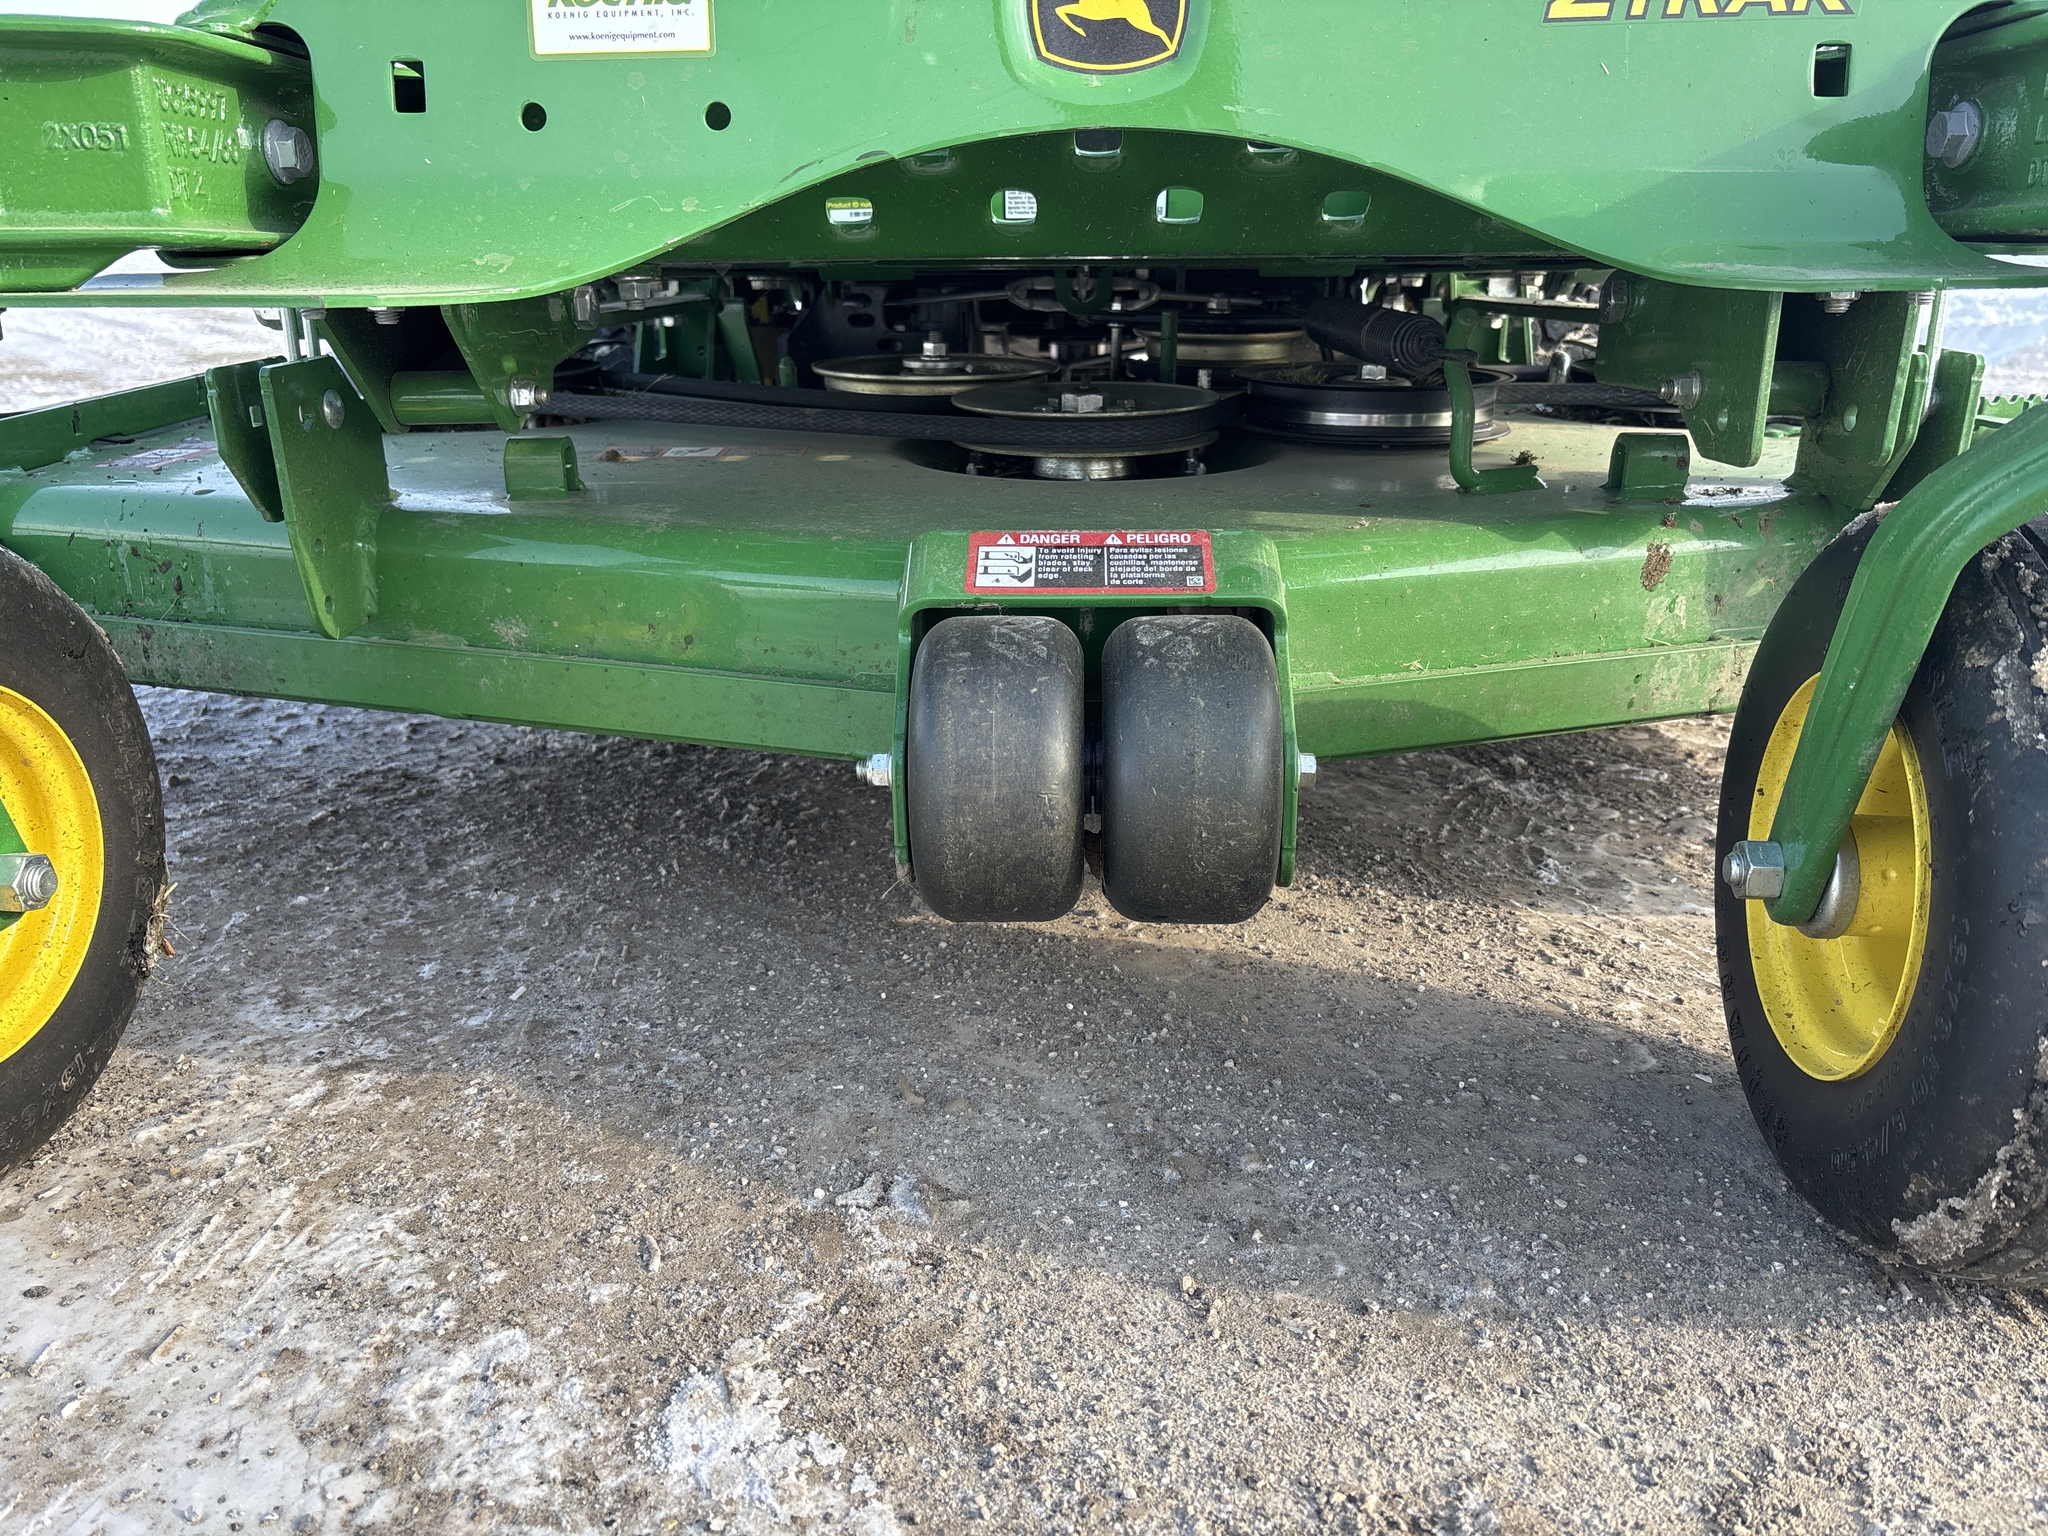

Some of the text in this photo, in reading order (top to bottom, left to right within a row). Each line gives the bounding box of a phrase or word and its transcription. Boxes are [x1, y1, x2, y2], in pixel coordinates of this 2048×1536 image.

[547, 9, 695, 20] KOENIG EQUIPMENT, INC.
[568, 30, 676, 42] www.koenigequipment.com
[1019, 534, 1081, 544] DANGER
[1126, 533, 1191, 544] PELIGRO
